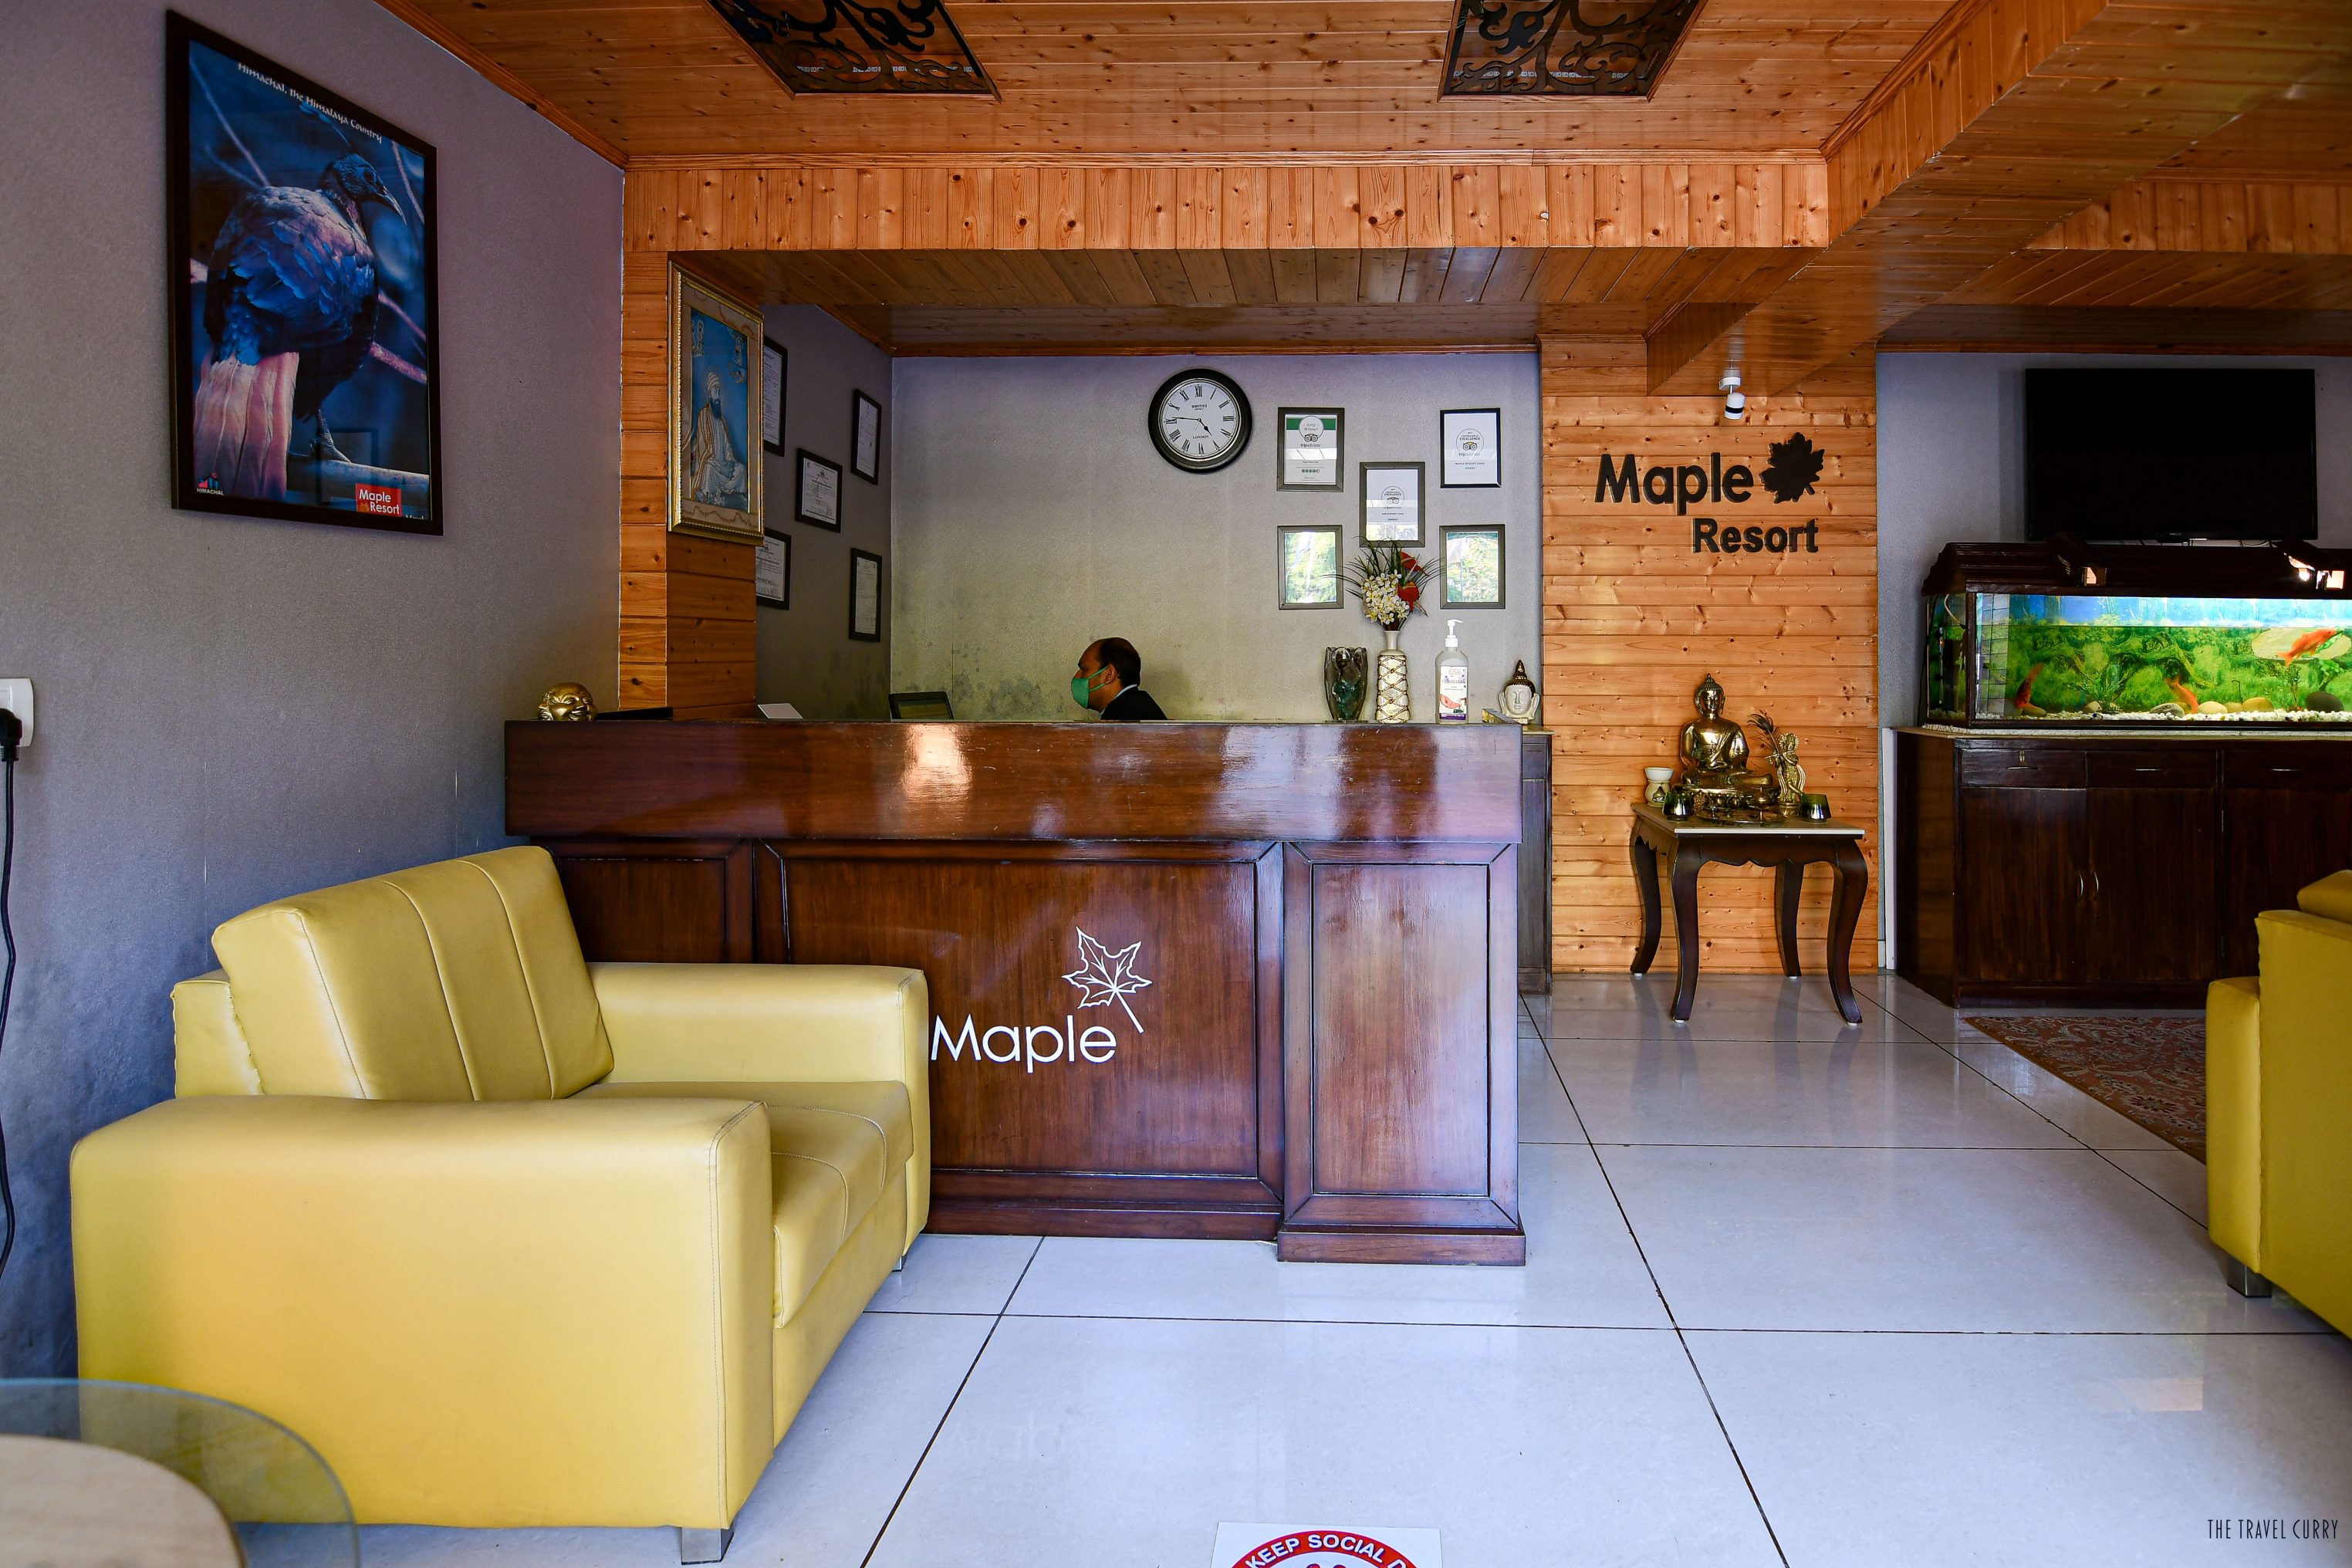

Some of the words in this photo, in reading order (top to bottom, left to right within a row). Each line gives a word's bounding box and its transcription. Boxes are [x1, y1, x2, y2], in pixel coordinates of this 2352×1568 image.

[289, 88, 304, 102] the
[306, 96, 349, 124] Himalaya
[350, 119, 383, 144] Country
[196, 487, 225, 495] HIMACHAL
[359, 488, 392, 503] Maple
[1594, 451, 1755, 516] Maple
[370, 501, 400, 515] Resort
[1692, 518, 1820, 554] Resort
[930, 1013, 1117, 1074] Maple
[1245, 1537, 1299, 1568] KEEP
[1307, 1533, 1385, 1563] SOCIAL
